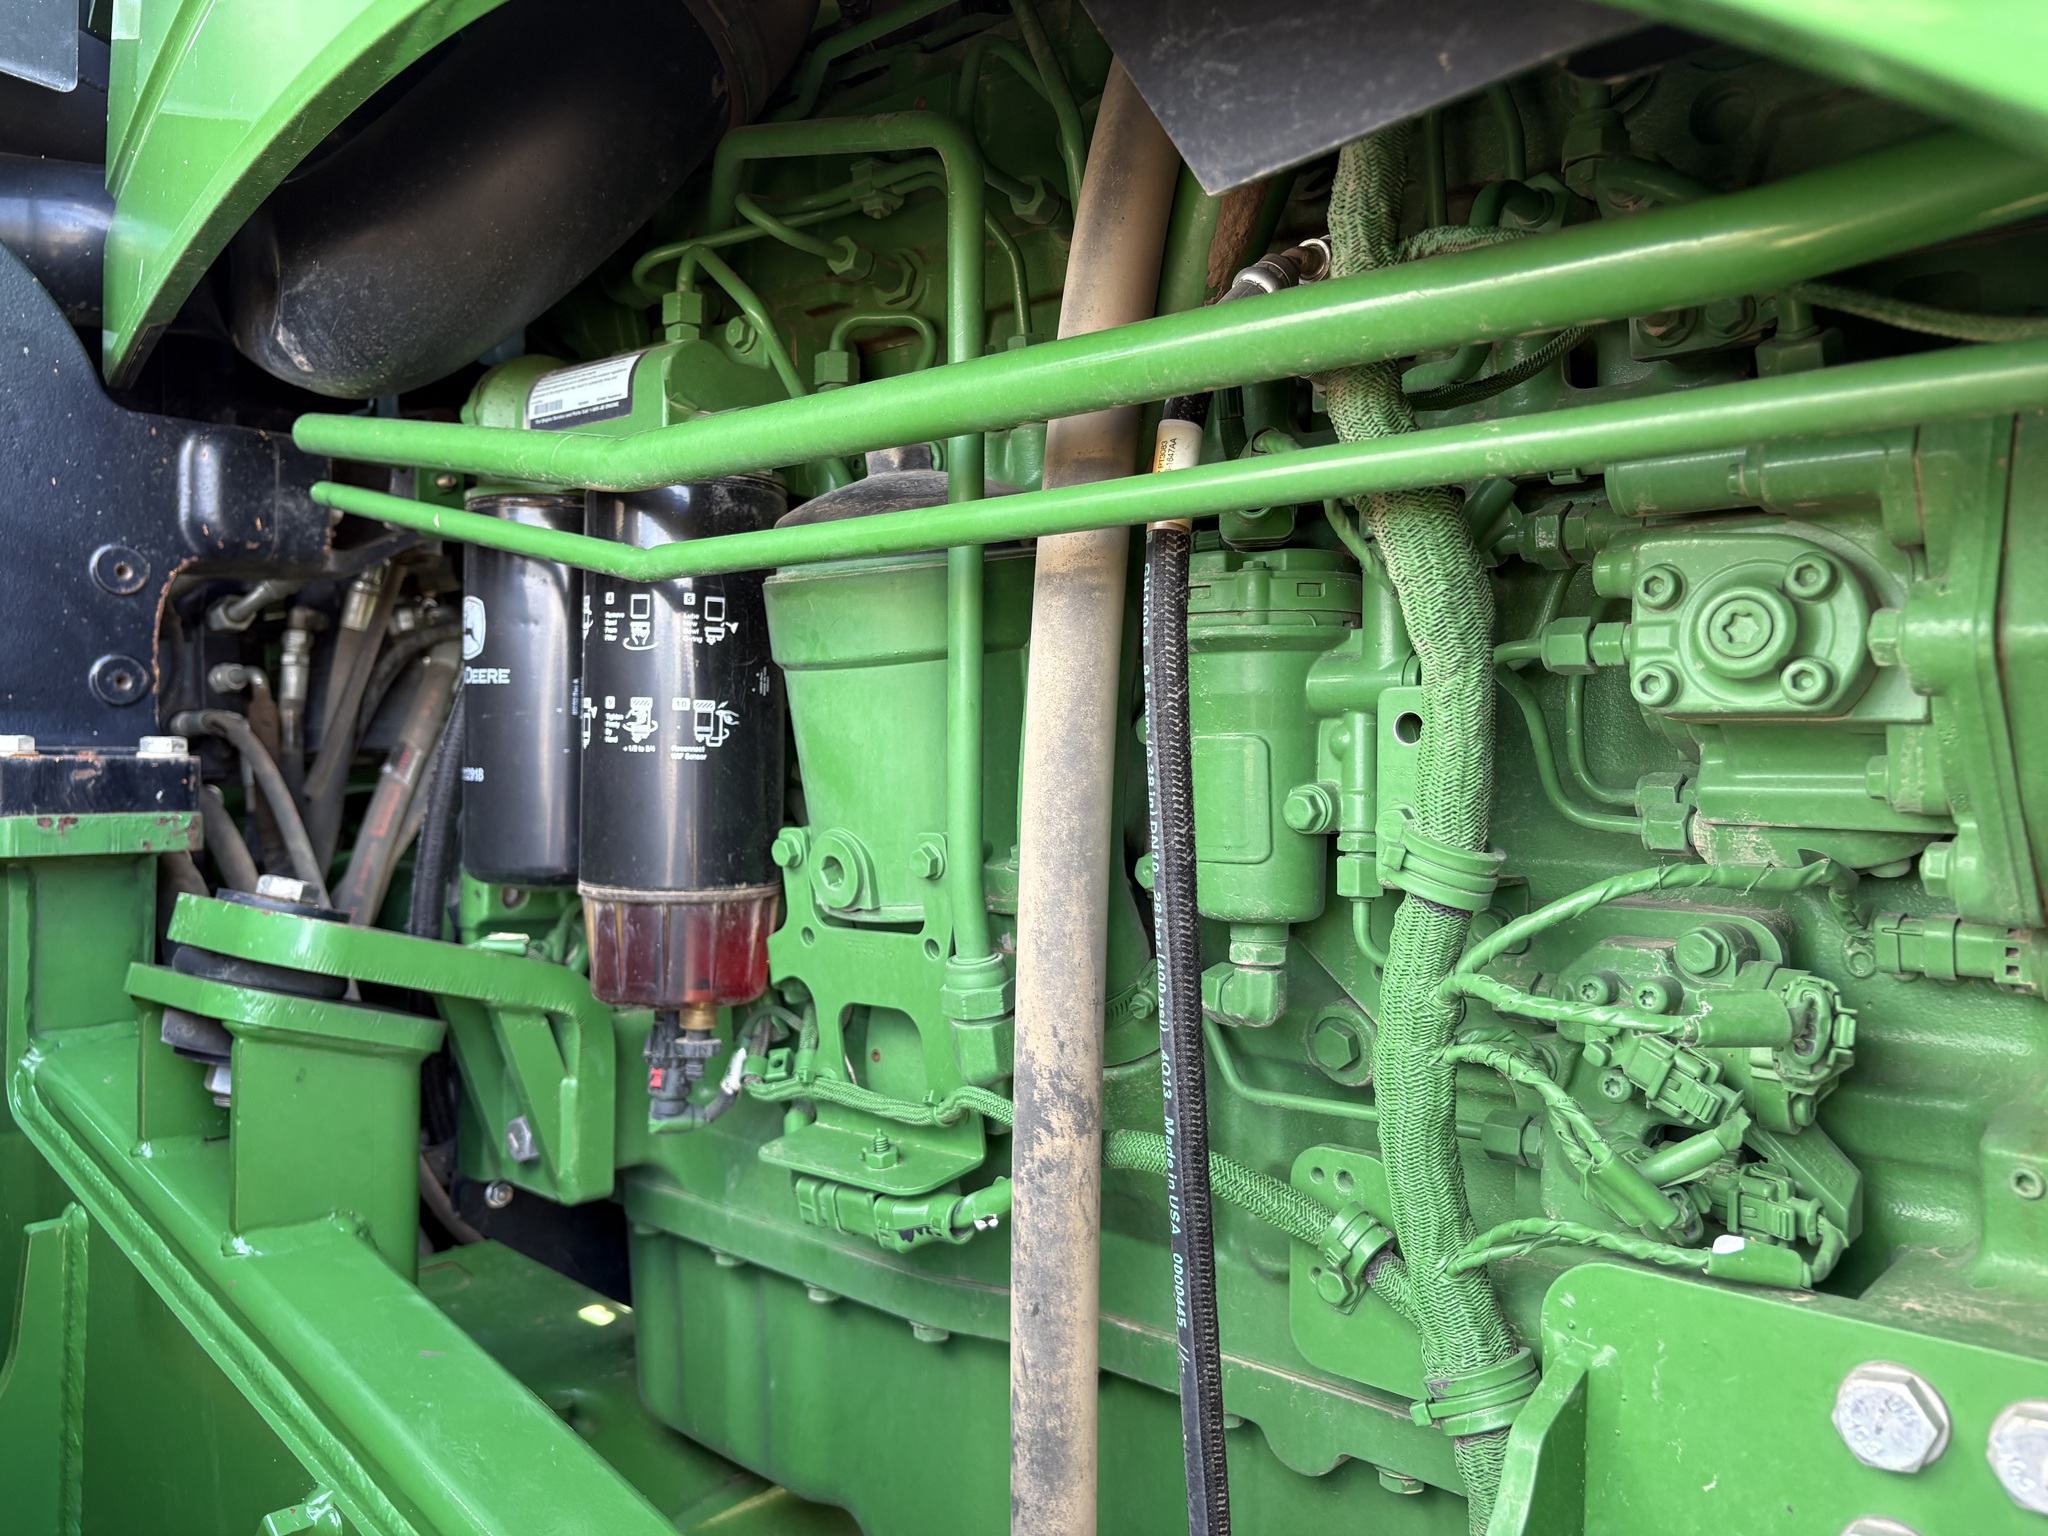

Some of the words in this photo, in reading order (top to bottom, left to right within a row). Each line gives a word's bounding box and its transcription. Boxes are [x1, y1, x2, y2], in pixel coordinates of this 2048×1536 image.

[1158, 440, 1168, 469] PT3083
[464, 666, 511, 684] DEERE
[670, 744, 705, 753] Reconnect
[684, 752, 708, 761] Sensor
[1154, 891, 1162, 913] 28
[1154, 918, 1163, 949] bar
[1156, 953, 1168, 993] (400
[1158, 1002, 1169, 1032] psi)
[1164, 1115, 1177, 1169] Made
[1168, 1173, 1178, 1190] in
[1168, 1195, 1182, 1235] USA
[1172, 1252, 1187, 1329] 0000445
